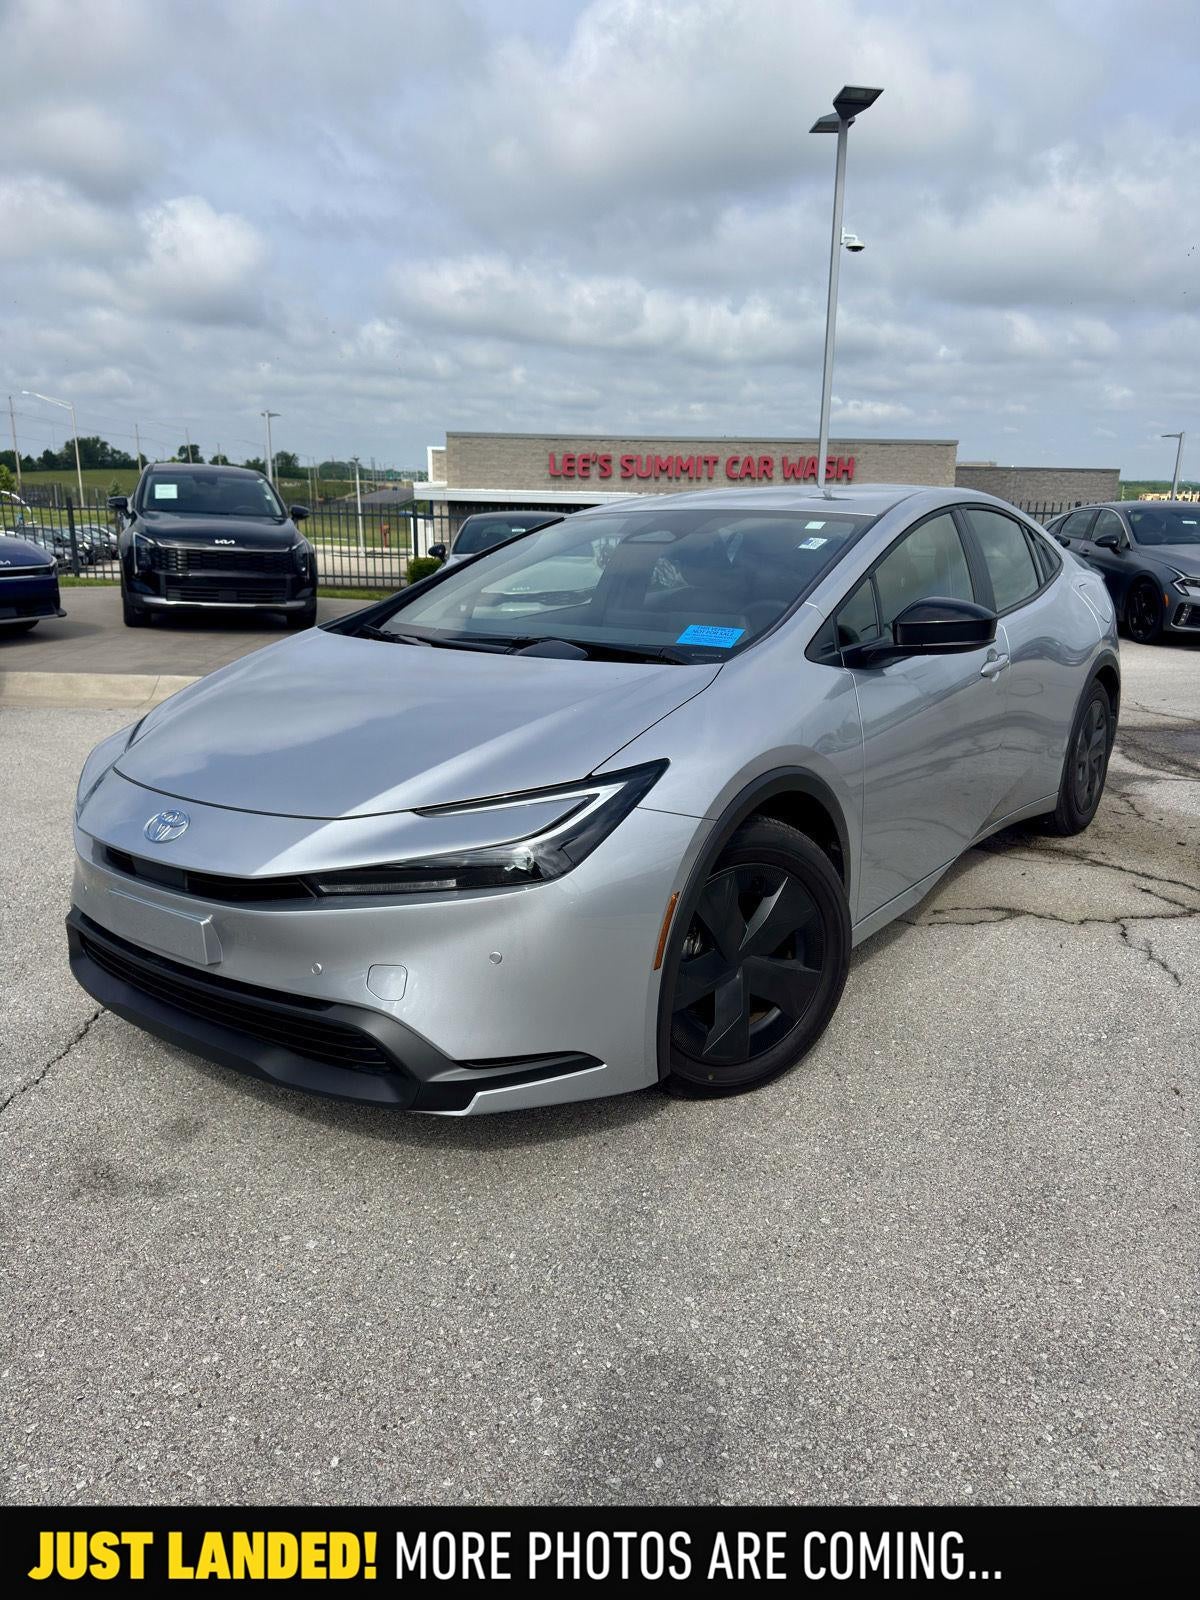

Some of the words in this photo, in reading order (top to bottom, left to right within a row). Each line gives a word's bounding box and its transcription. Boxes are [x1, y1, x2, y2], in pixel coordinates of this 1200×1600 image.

[548, 452, 613, 478] LEE'S
[620, 454, 719, 479] SUMMIT
[726, 456, 774, 479] CAR
[782, 456, 856, 480] WASH
